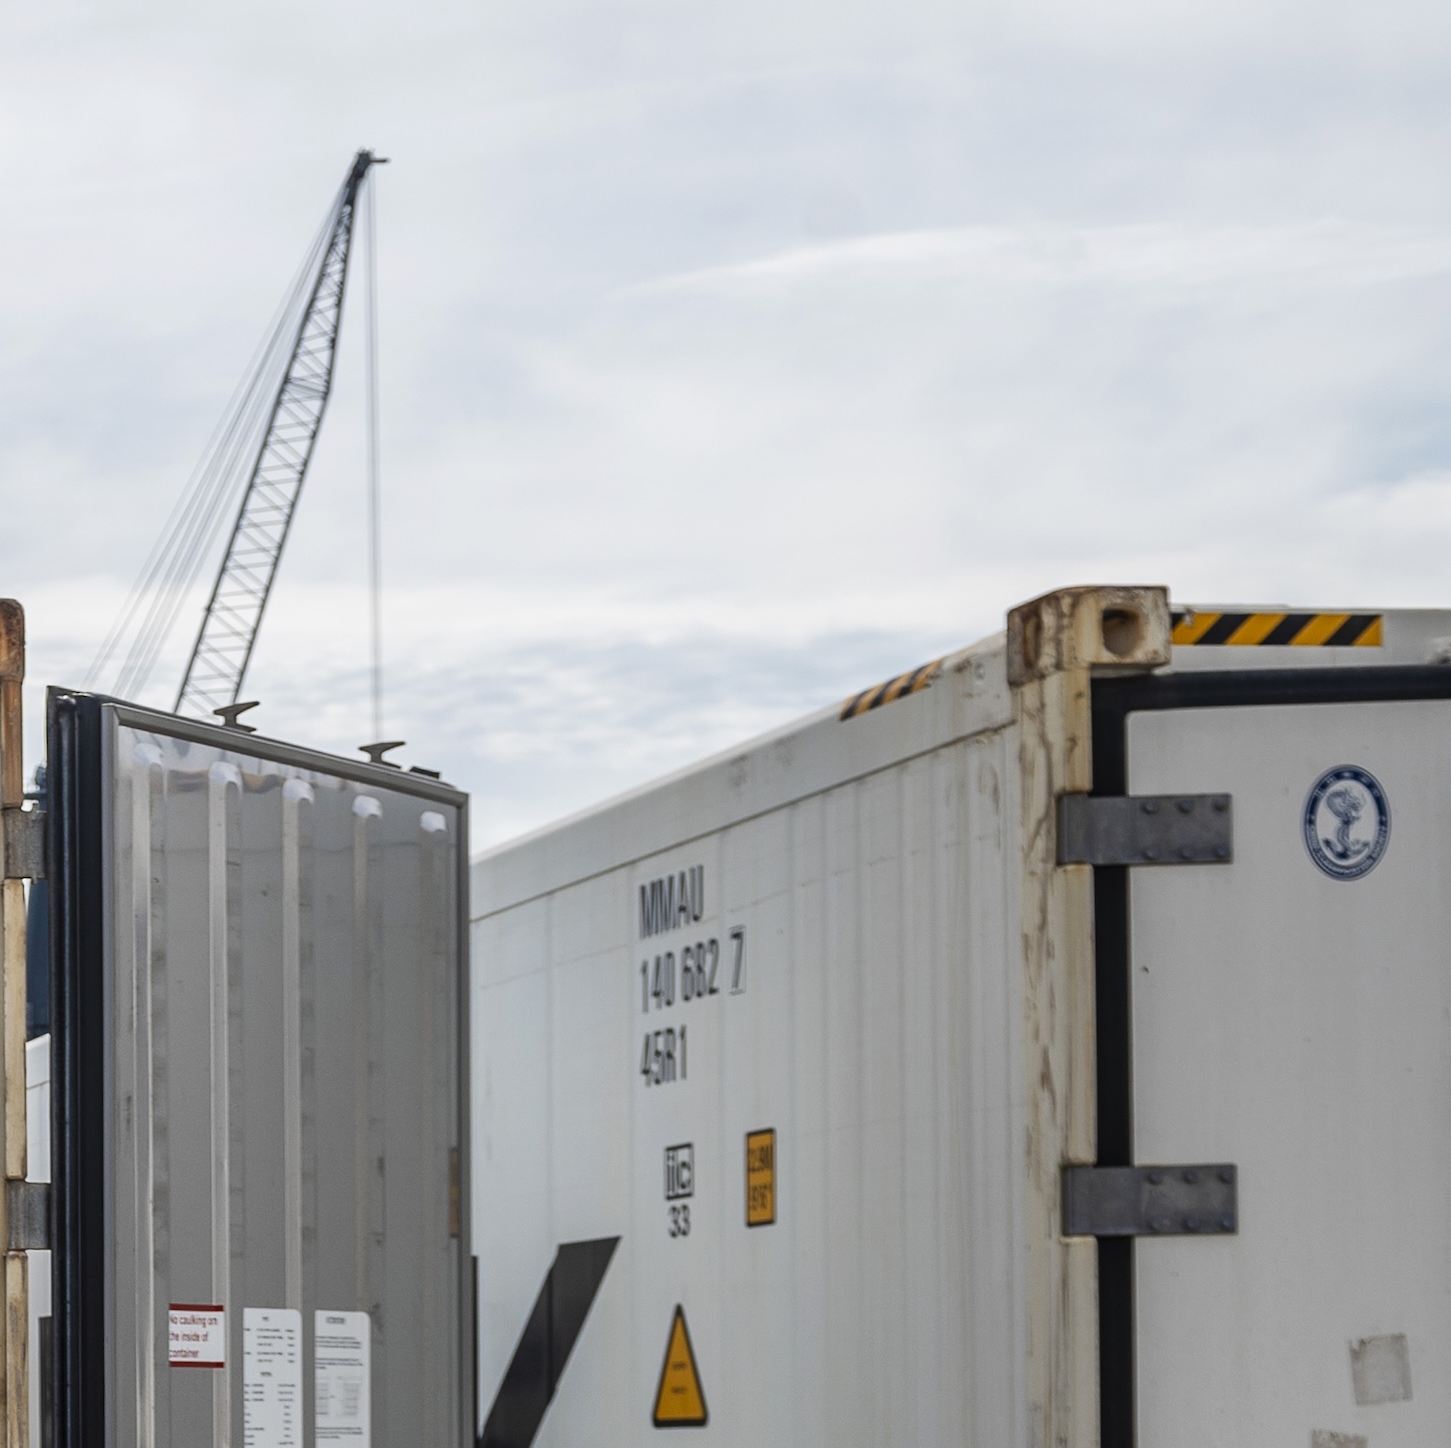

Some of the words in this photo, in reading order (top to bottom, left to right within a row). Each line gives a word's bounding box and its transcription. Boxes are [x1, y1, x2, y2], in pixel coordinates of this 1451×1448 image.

[639, 863, 705, 940] MMAU
[640, 950, 676, 1013] 140
[681, 936, 720, 1002] 682
[668, 1203, 691, 1238] 33
[169, 1349, 199, 1359] container
